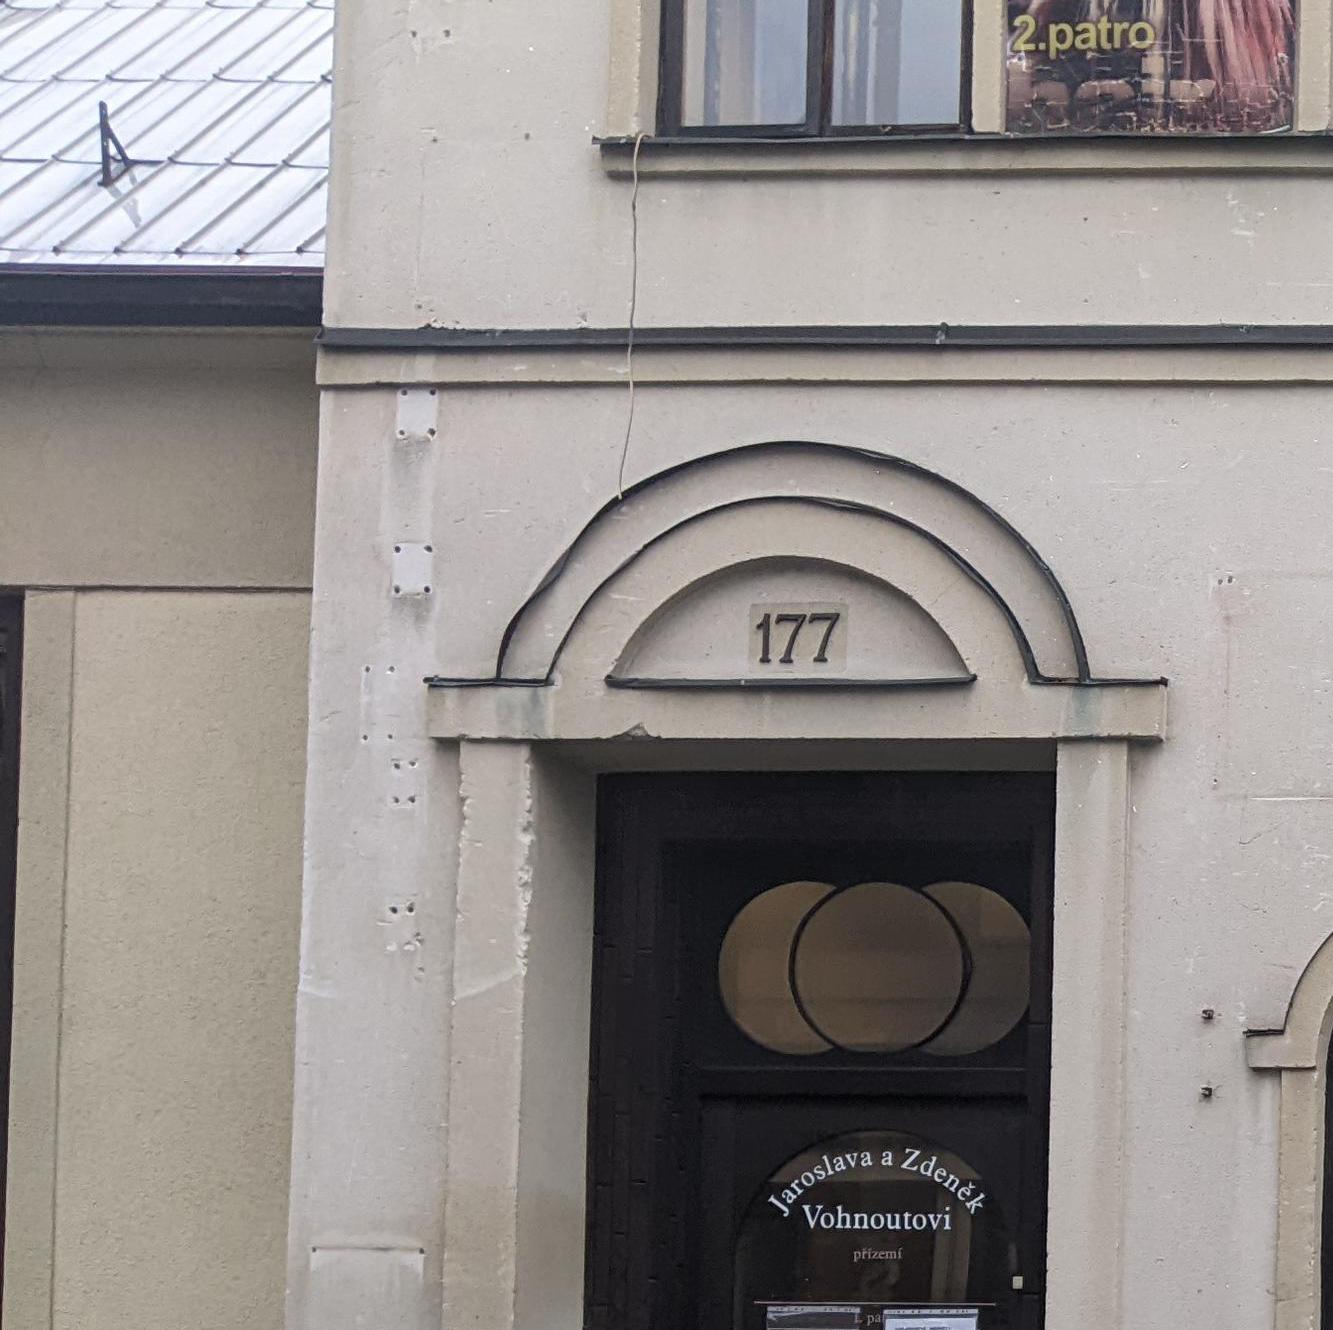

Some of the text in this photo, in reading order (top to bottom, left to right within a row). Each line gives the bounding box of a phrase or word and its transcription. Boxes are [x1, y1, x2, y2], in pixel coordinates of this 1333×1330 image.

[1011, 14, 1157, 60] 2.patro
[756, 612, 840, 663] 177
[768, 1148, 984, 1217] Jaroslava a Zdeněk
[802, 1204, 952, 1231] Vohnoutovi
[853, 1247, 903, 1263] přízemí
